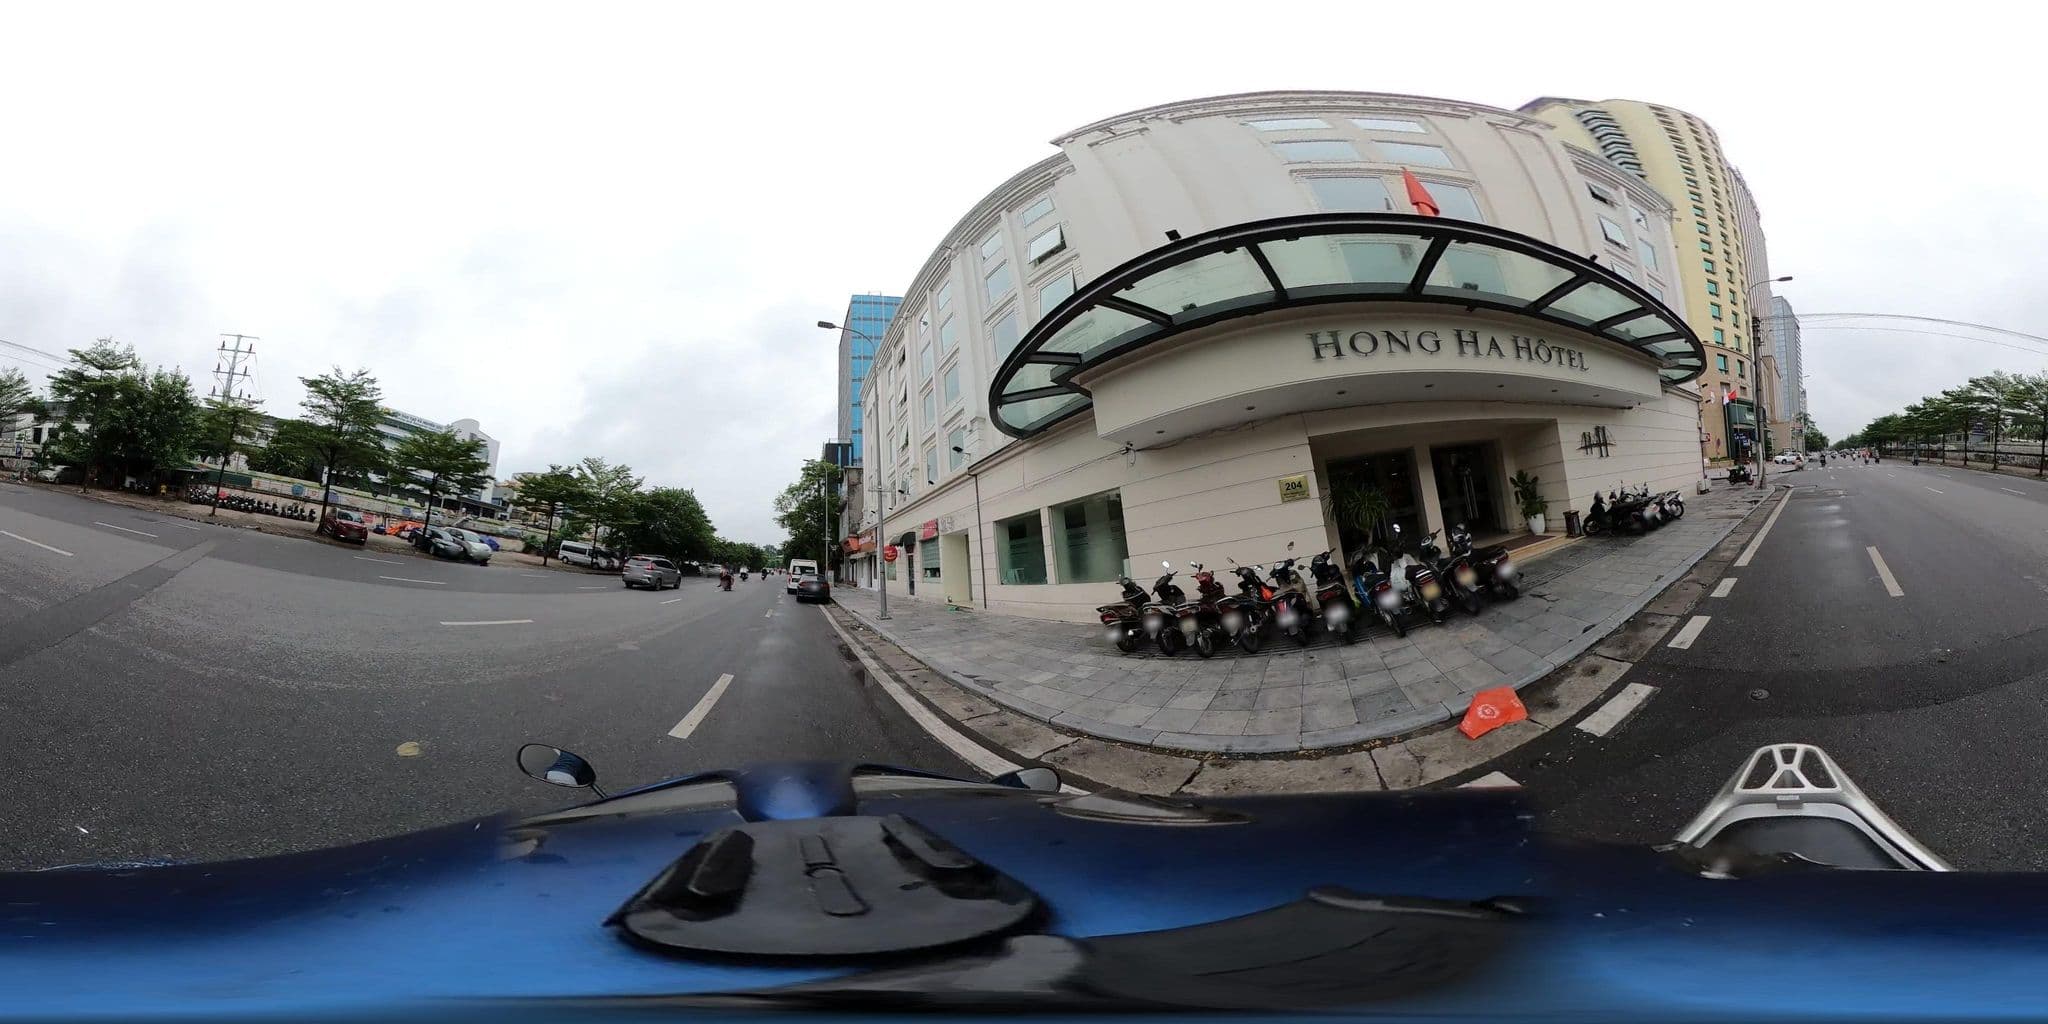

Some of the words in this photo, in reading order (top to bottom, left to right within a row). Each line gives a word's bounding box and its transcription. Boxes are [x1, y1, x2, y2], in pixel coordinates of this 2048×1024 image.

[1306, 329, 1443, 360] HONG
[1453, 328, 1505, 357] HA
[1513, 334, 1589, 371] HÔTEL
[1285, 481, 1302, 491] 204
